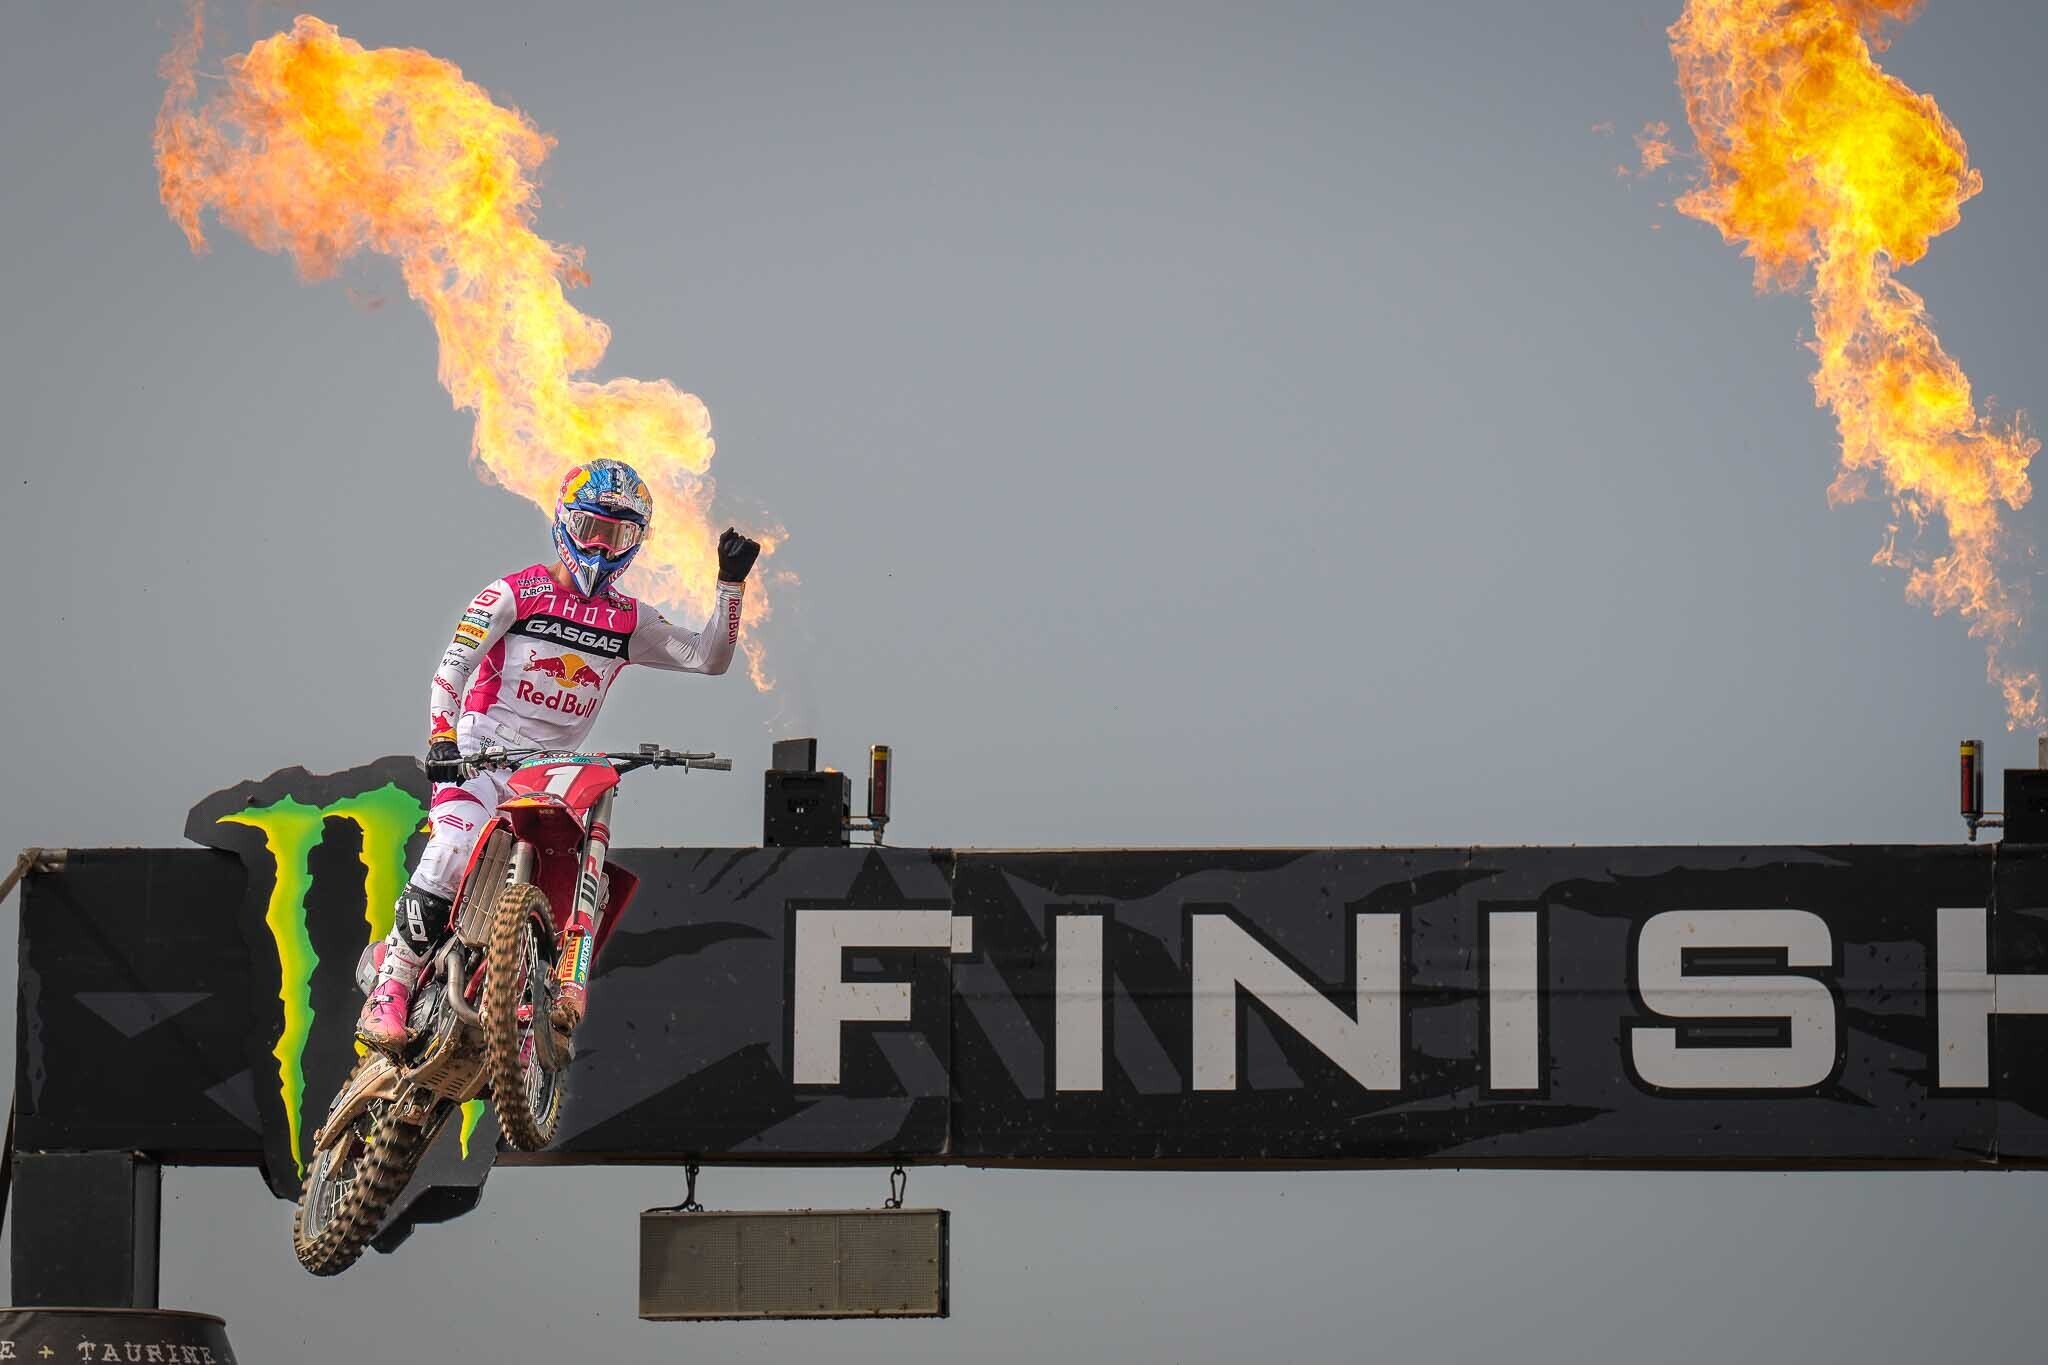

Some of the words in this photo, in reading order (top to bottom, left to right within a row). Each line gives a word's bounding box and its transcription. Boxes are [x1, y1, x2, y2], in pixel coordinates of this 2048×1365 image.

[525, 619, 623, 653] GASGAS
[516, 679, 563, 711] Red
[562, 693, 597, 719] Bull
[544, 766, 584, 799] 1
[78, 1341, 216, 1363] TAURINE
